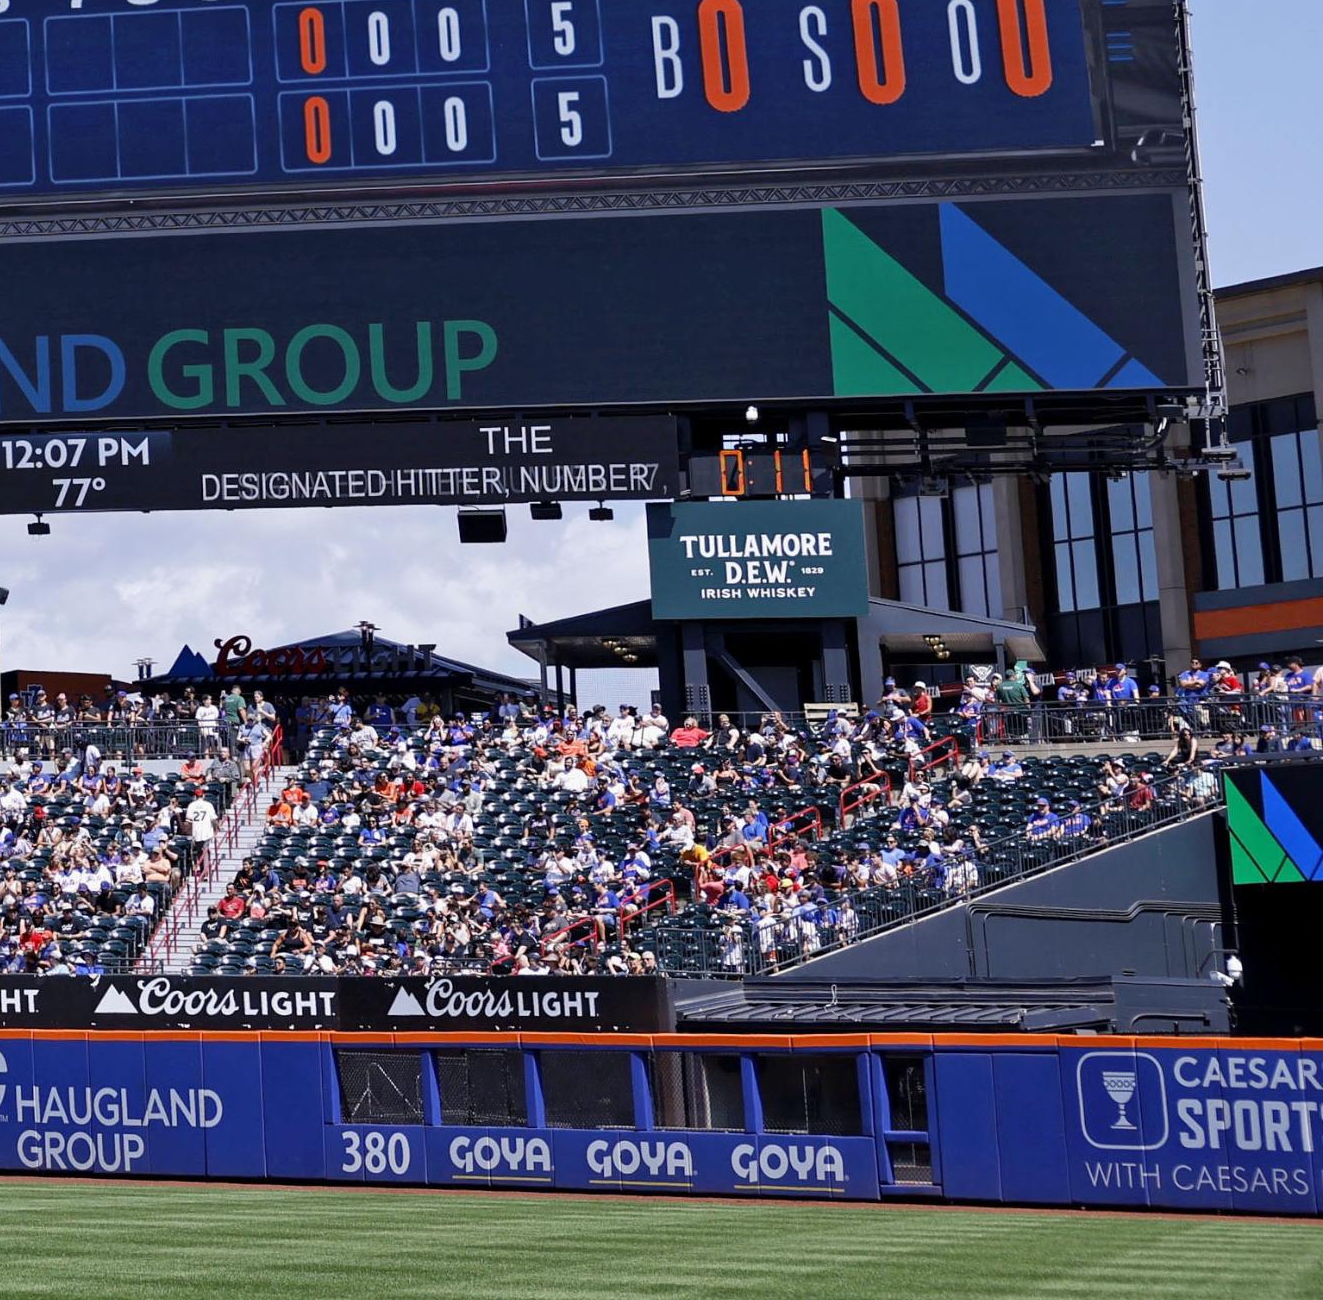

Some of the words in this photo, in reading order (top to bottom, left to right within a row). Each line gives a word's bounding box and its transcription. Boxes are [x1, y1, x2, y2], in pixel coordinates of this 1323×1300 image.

[299, 6, 327, 76] 0
[367, 10, 391, 67] 0
[438, 6, 462, 64] 0
[552, 1, 575, 56] 5
[652, 15, 684, 100] B
[799, 5, 833, 92] S
[560, 92, 583, 147] 5
[147, 318, 499, 409] GROUP
[1, 439, 91, 470] 12:07
[98, 436, 150, 468] PM
[479, 426, 554, 455] THE
[53, 477, 106, 508] 77°
[202, 469, 386, 501] DESIGNATED
[679, 533, 833, 558] TULLAMORE
[691, 569, 714, 577] EST.
[801, 567, 824, 575] 1829
[701, 588, 741, 599] IRISH
[747, 587, 815, 599] WHISKEY
[214, 635, 329, 675] Coors
[333, 643, 437, 673] LIGHT
[193, 811, 207, 822] 27
[137, 977, 239, 1016] Coors
[244, 991, 336, 1016] LIGHT
[425, 976, 514, 1018] Coors
[517, 990, 600, 1018] LIGHT
[16, 1085, 222, 1129] HAUGLAND
[17, 1130, 145, 1173] GROUP
[342, 1131, 411, 1175] 380
[449, 1136, 551, 1173] GOYA
[587, 1140, 692, 1178] GOYA
[731, 1144, 845, 1183] GOYA
[1086, 1162, 1161, 1188] WITH
[1173, 1165, 1309, 1195] CAESARS
